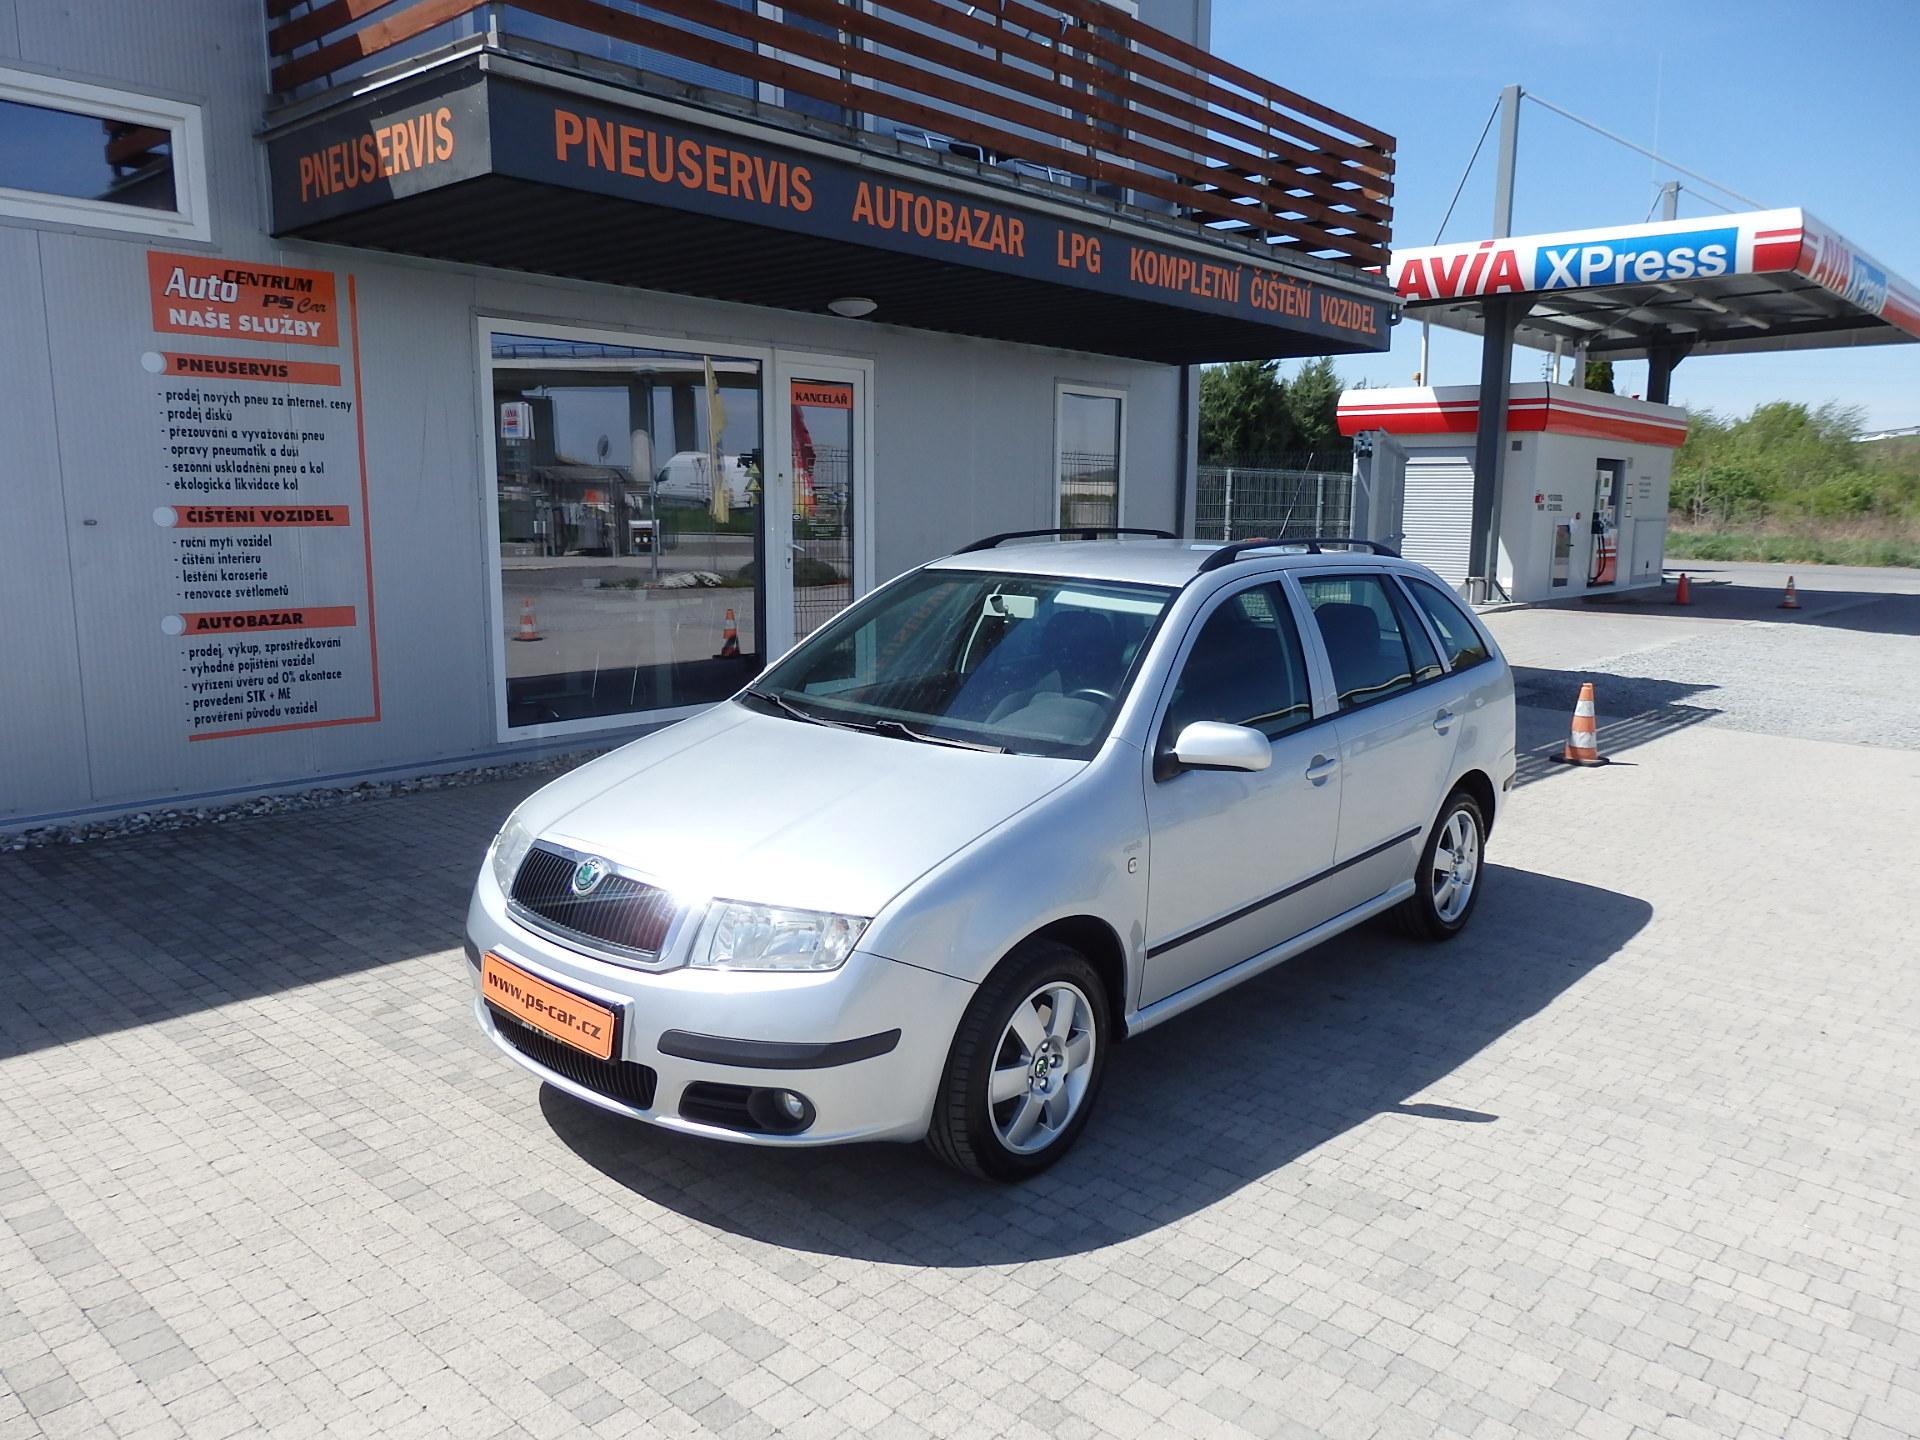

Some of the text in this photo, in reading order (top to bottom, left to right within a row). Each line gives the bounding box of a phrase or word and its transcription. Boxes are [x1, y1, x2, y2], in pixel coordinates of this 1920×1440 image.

[300, 107, 455, 202] PNEUSERVIS
[554, 108, 1377, 335] PNEUSERVIS AUTOBAZAR LPG KOMPLETNÍ ČIŠTĚNÍ VOZIDEL
[1542, 241, 1728, 289] XPress
[163, 266, 313, 303] Auto CENTRUM
[262, 294, 327, 313] PS Car
[169, 307, 321, 337] NAŠE SLUŽBY
[177, 358, 288, 378] PNEUSERVIS
[166, 388, 200, 405] prodej
[244, 395, 269, 407] pneu
[272, 397, 284, 406] za
[330, 400, 352, 413] ceny
[167, 407, 202, 423] prodej
[231, 430, 238, 439] a
[302, 432, 325, 443] pneu
[171, 446, 208, 458] opravy
[212, 444, 267, 458] pneumatik
[270, 448, 277, 456] a
[274, 464, 297, 476] pneu
[300, 465, 306, 474] a
[309, 461, 325, 474] kol
[234, 477, 280, 490] likvidace
[283, 477, 299, 490] kol
[186, 506, 334, 523] ČIŠTĚNÍ VOZIDEL
[236, 534, 272, 547] vozidel
[221, 568, 268, 581] karoserie
[184, 589, 232, 600] renovace
[197, 612, 303, 630] AUTOBAZAR
[282, 653, 315, 667] vozidel
[267, 673, 279, 685] od
[282, 671, 296, 684] 0%
[299, 669, 342, 682] akontace
[247, 690, 266, 703] STK
[278, 687, 291, 700] ME
[284, 700, 318, 715] vozidel
[488, 971, 602, 1040] www.ps-car.cz
